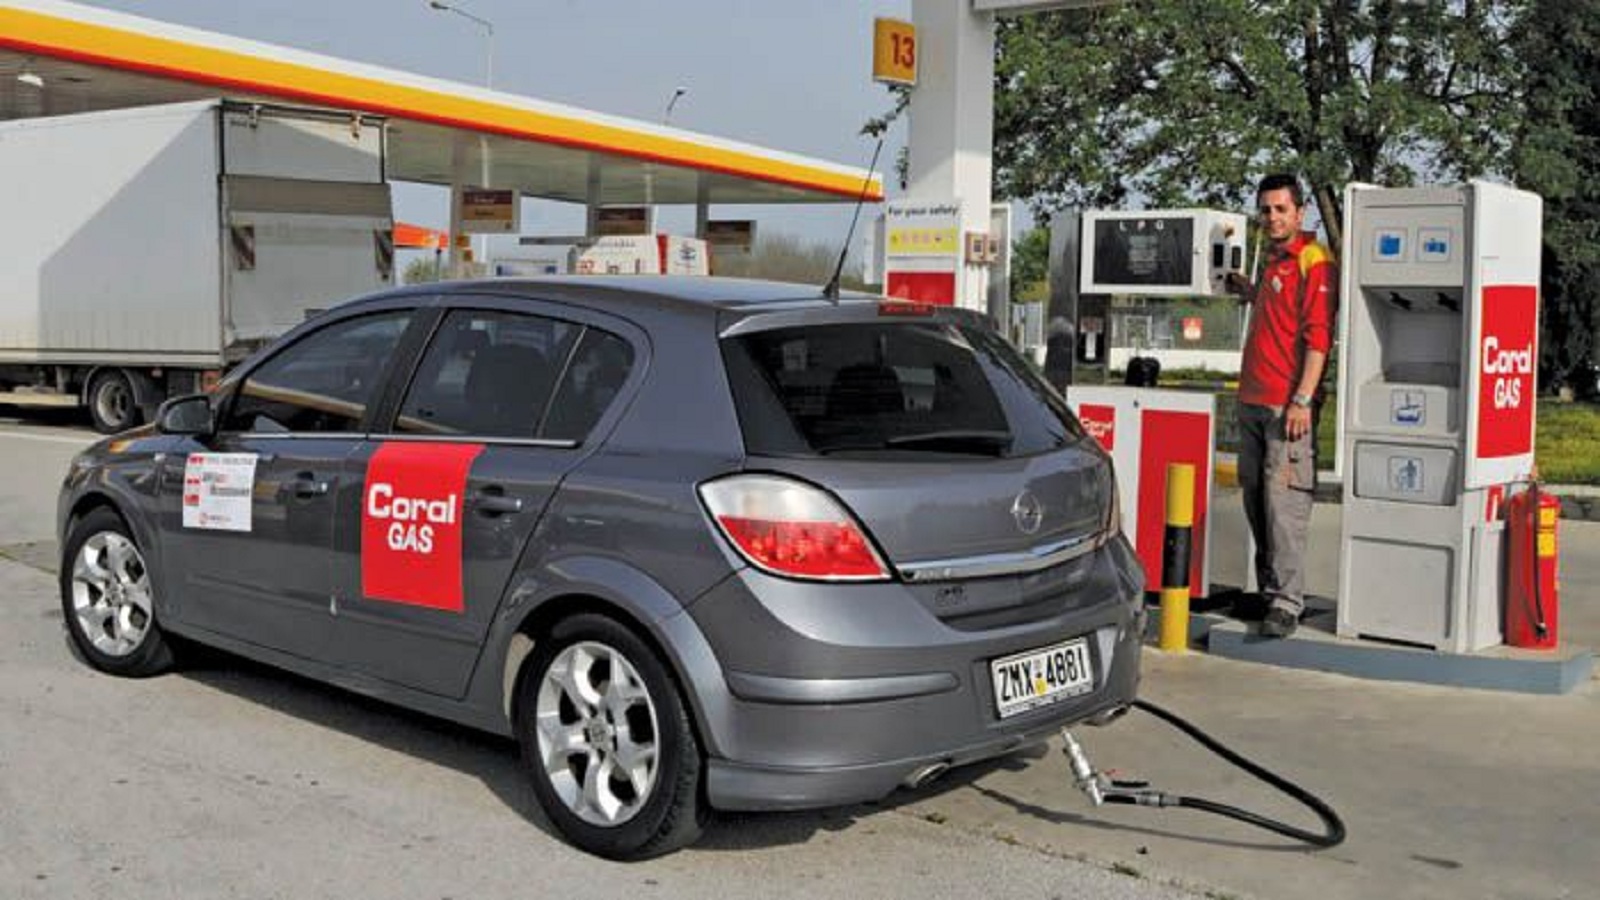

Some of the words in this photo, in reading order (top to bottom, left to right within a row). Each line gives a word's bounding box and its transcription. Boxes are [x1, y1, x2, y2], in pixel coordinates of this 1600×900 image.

[891, 32, 914, 69] 13
[888, 206, 903, 215] For
[905, 207, 927, 218] your
[1483, 336, 1532, 374] Coral
[1494, 377, 1521, 410] GAS
[368, 483, 457, 524] Coral
[388, 521, 434, 554] GAS
